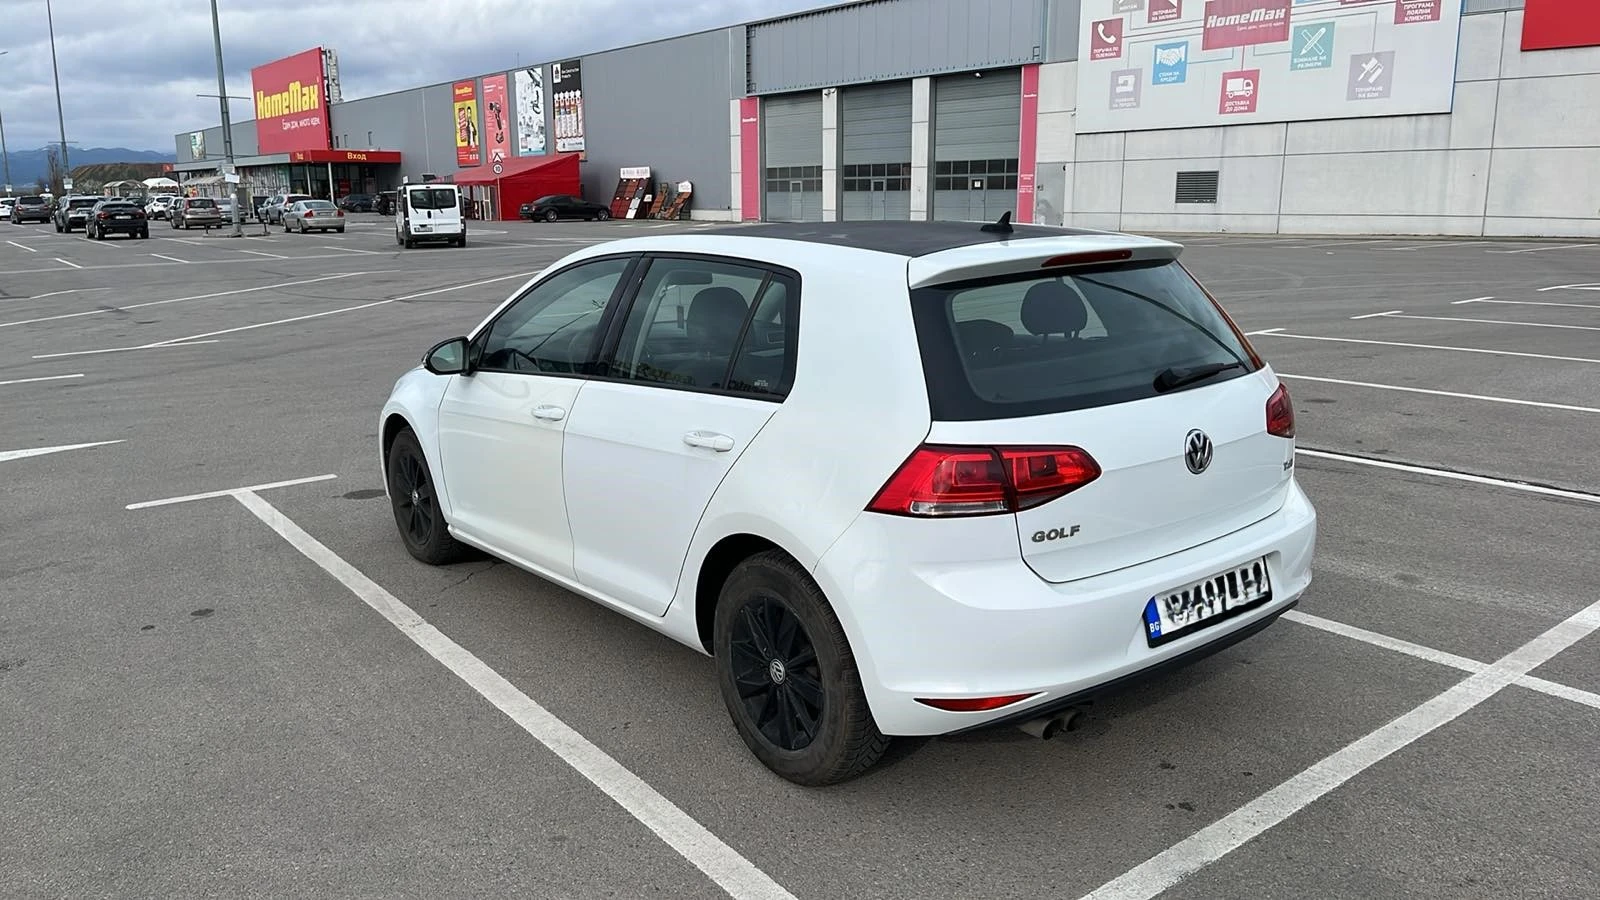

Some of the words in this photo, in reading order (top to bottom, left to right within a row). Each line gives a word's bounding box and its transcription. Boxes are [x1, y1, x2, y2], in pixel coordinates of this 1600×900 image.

[1403, 2, 1435, 10] ПРОГРАМА
[1206, 8, 1286, 28] HomeMax
[256, 80, 319, 120] HomeMax
[347, 152, 367, 160] Вход
[1031, 524, 1081, 543] GOLF
[1149, 621, 1160, 633] BG
